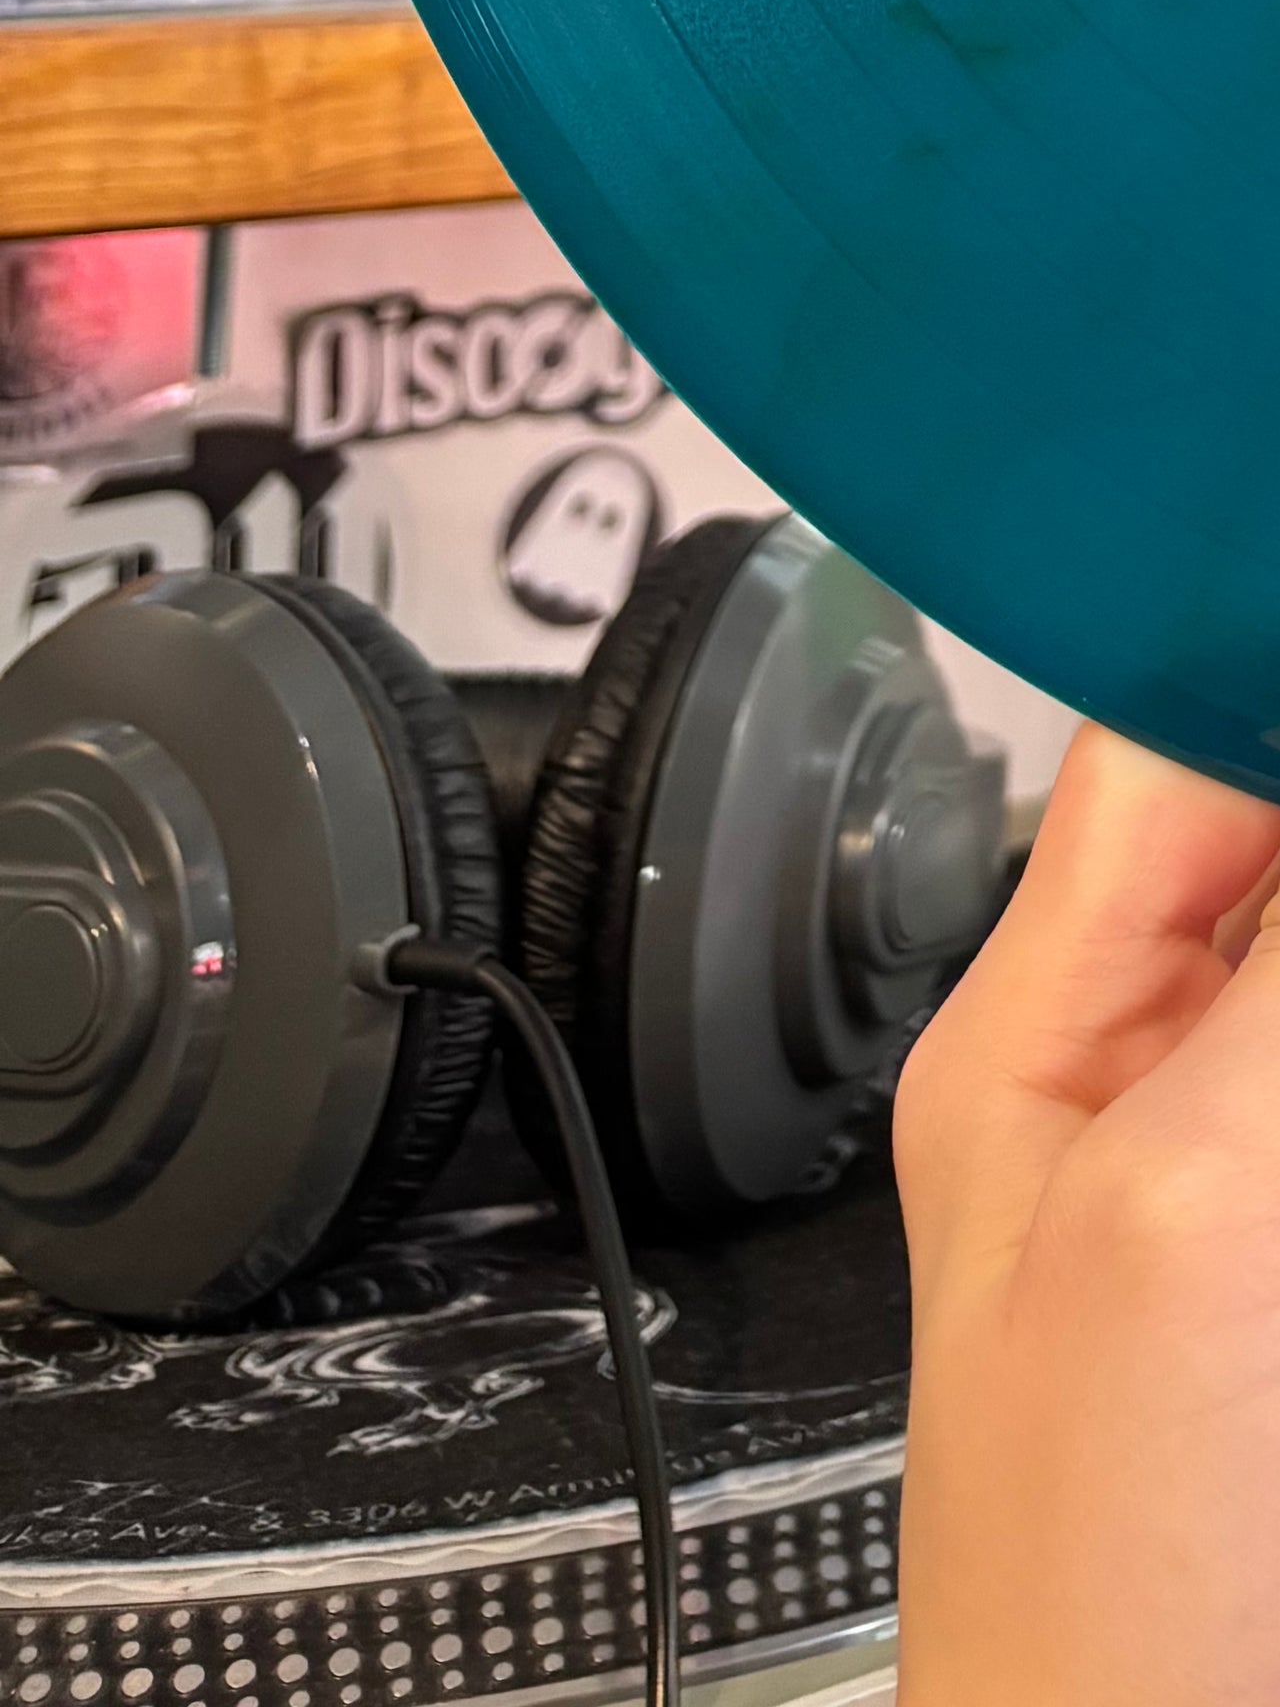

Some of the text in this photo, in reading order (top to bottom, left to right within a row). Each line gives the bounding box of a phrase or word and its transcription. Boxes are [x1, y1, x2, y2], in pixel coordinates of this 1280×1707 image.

[293, 295, 668, 450] Discog
[303, 1497, 430, 1529] 3306
[442, 1489, 496, 1510] W
[508, 1448, 734, 1504] Armige
